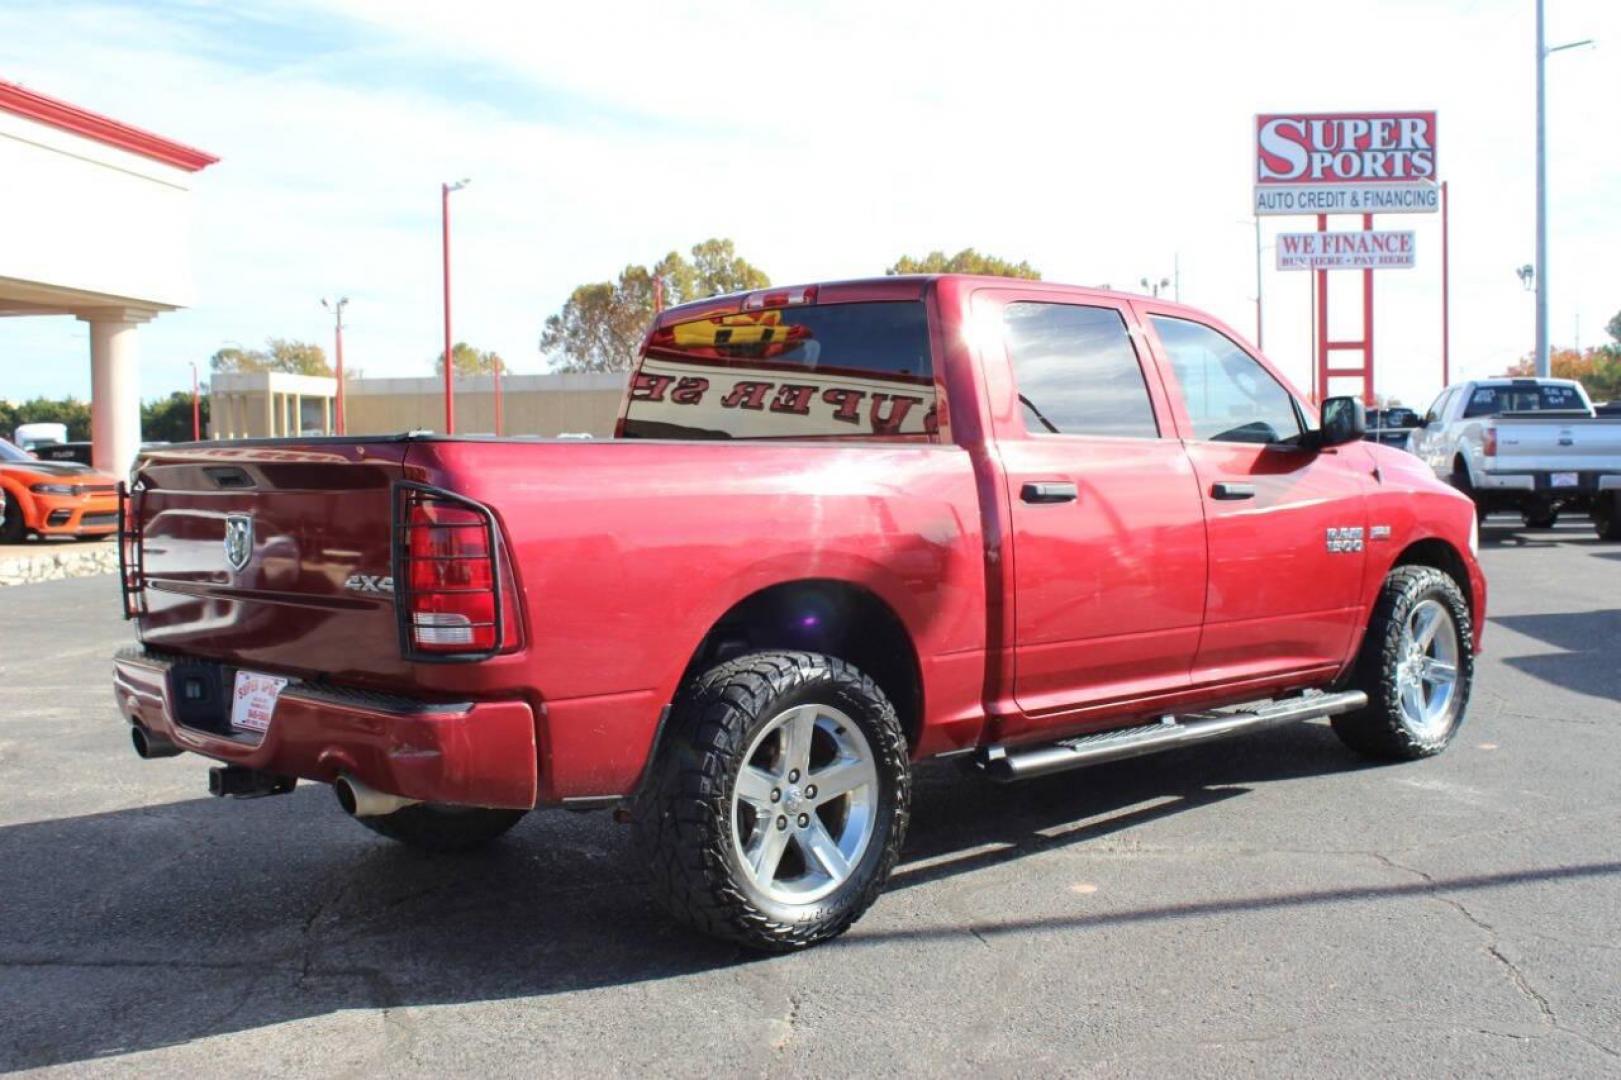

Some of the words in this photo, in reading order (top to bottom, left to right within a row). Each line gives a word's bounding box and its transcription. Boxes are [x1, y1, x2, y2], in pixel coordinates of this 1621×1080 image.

[1260, 118, 1431, 179] SUPER
[1258, 192, 1294, 209] AUTO
[1299, 191, 1346, 209] CREDIT
[1351, 191, 1360, 207] &
[1363, 190, 1437, 208] FINANCING
[1283, 236, 1315, 254] WE
[1321, 233, 1412, 253] FINANCE
